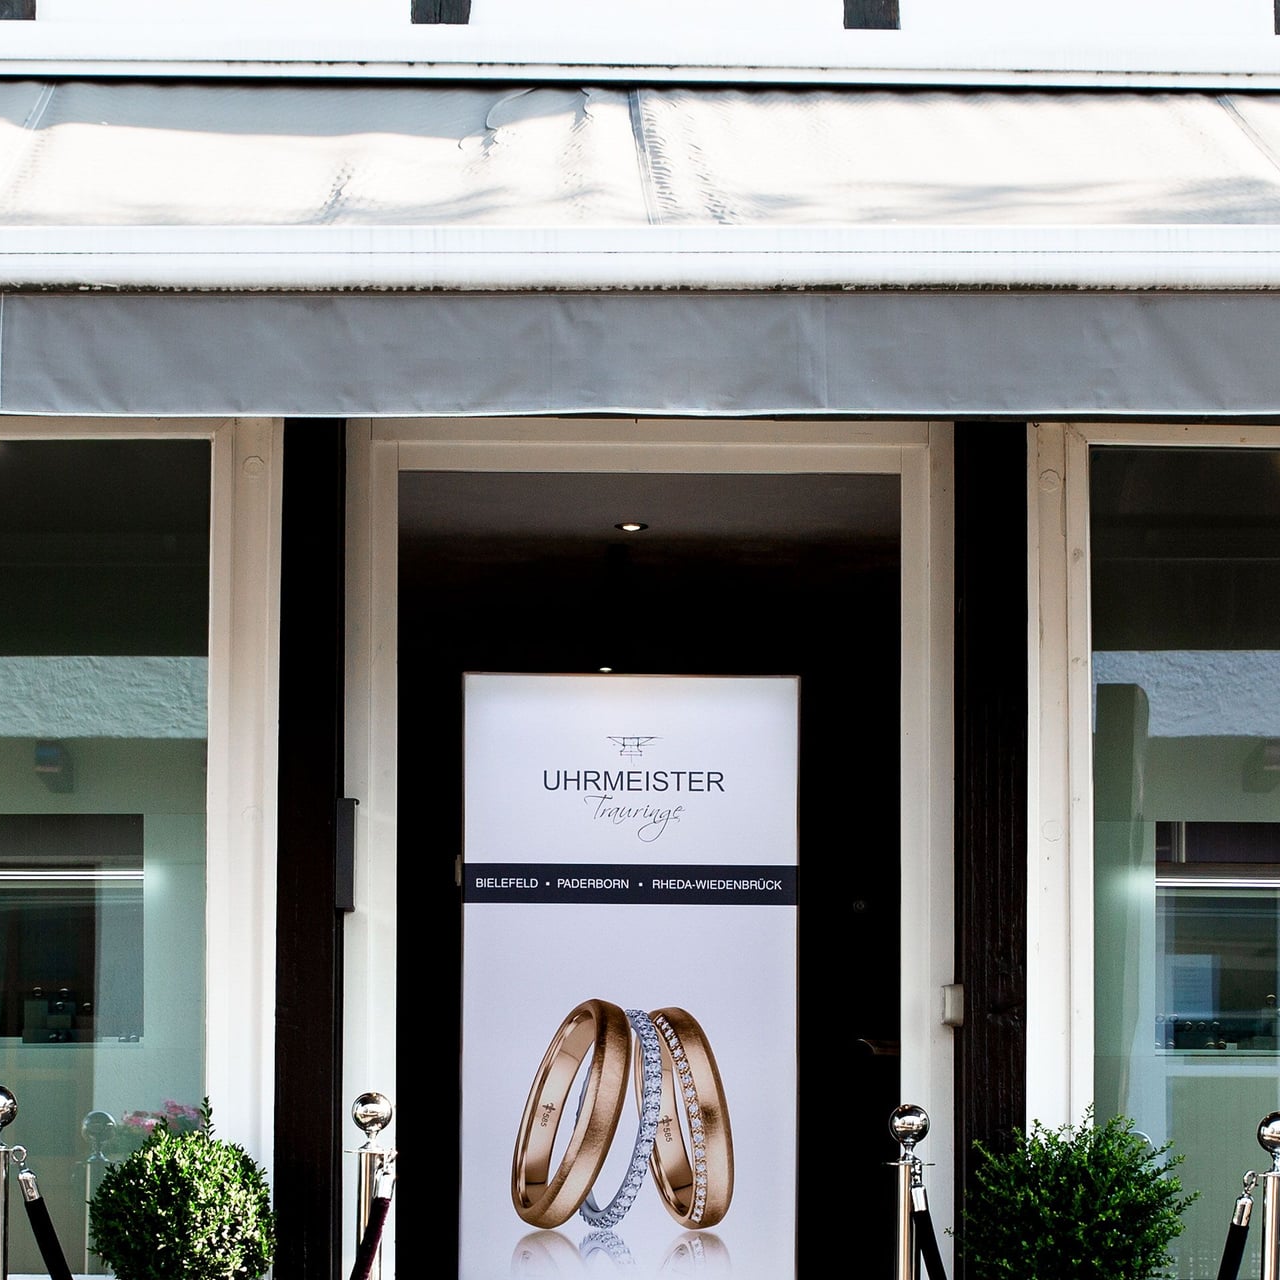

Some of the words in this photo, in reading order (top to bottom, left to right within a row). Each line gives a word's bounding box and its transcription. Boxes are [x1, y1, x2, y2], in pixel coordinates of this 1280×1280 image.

[543, 769, 726, 793] UHRMEISTER
[583, 794, 686, 843] Trauringe
[475, 877, 539, 889] BIELEFELD
[557, 878, 629, 890] PADERBORN
[651, 876, 782, 891] RHEDA-WIEDENBRÜCK
